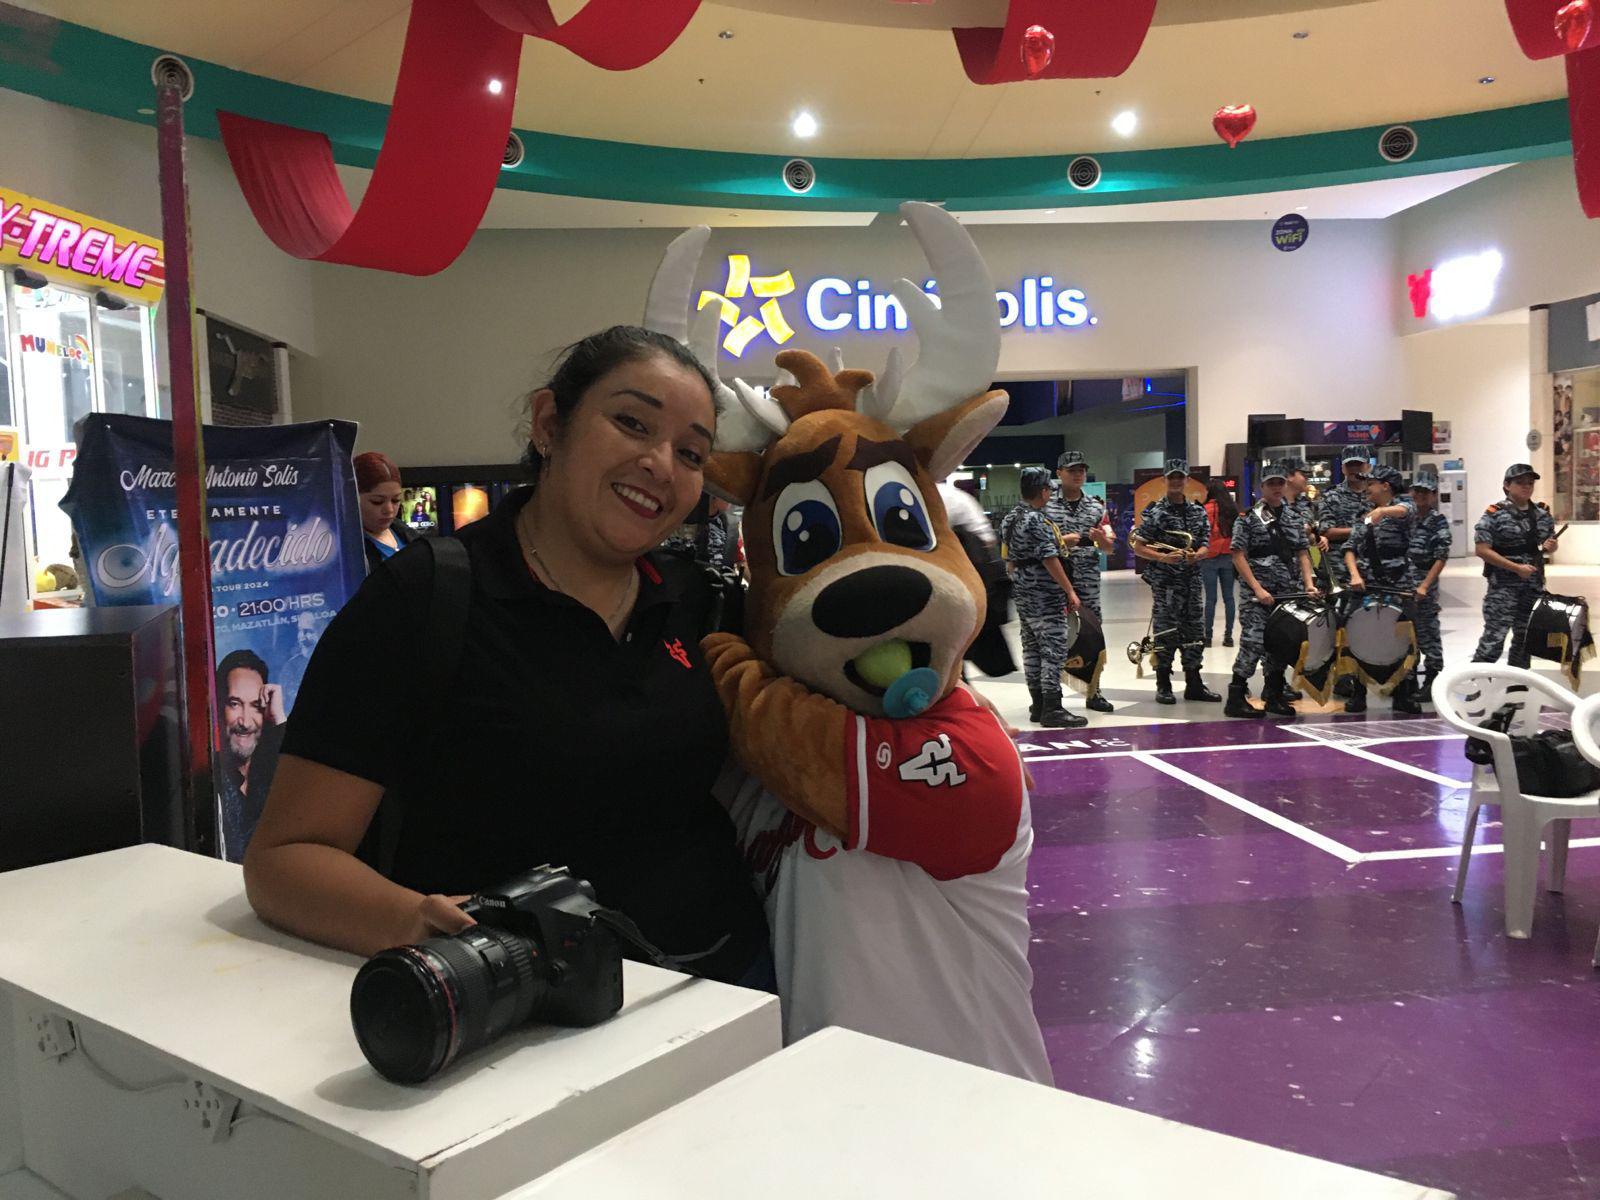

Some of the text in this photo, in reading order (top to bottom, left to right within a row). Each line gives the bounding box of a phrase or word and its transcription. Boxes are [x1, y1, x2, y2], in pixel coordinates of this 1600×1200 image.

[804, 276, 1098, 331] Cinolis.
[120, 464, 177, 491] Marc
[146, 505, 282, 520] ETEAMENTE
[97, 516, 334, 597] Agadecido
[216, 581, 269, 592] TOUR 2024
[239, 598, 286, 616] 21:00
[288, 592, 326, 610] HRS
[479, 896, 506, 908] Canon
